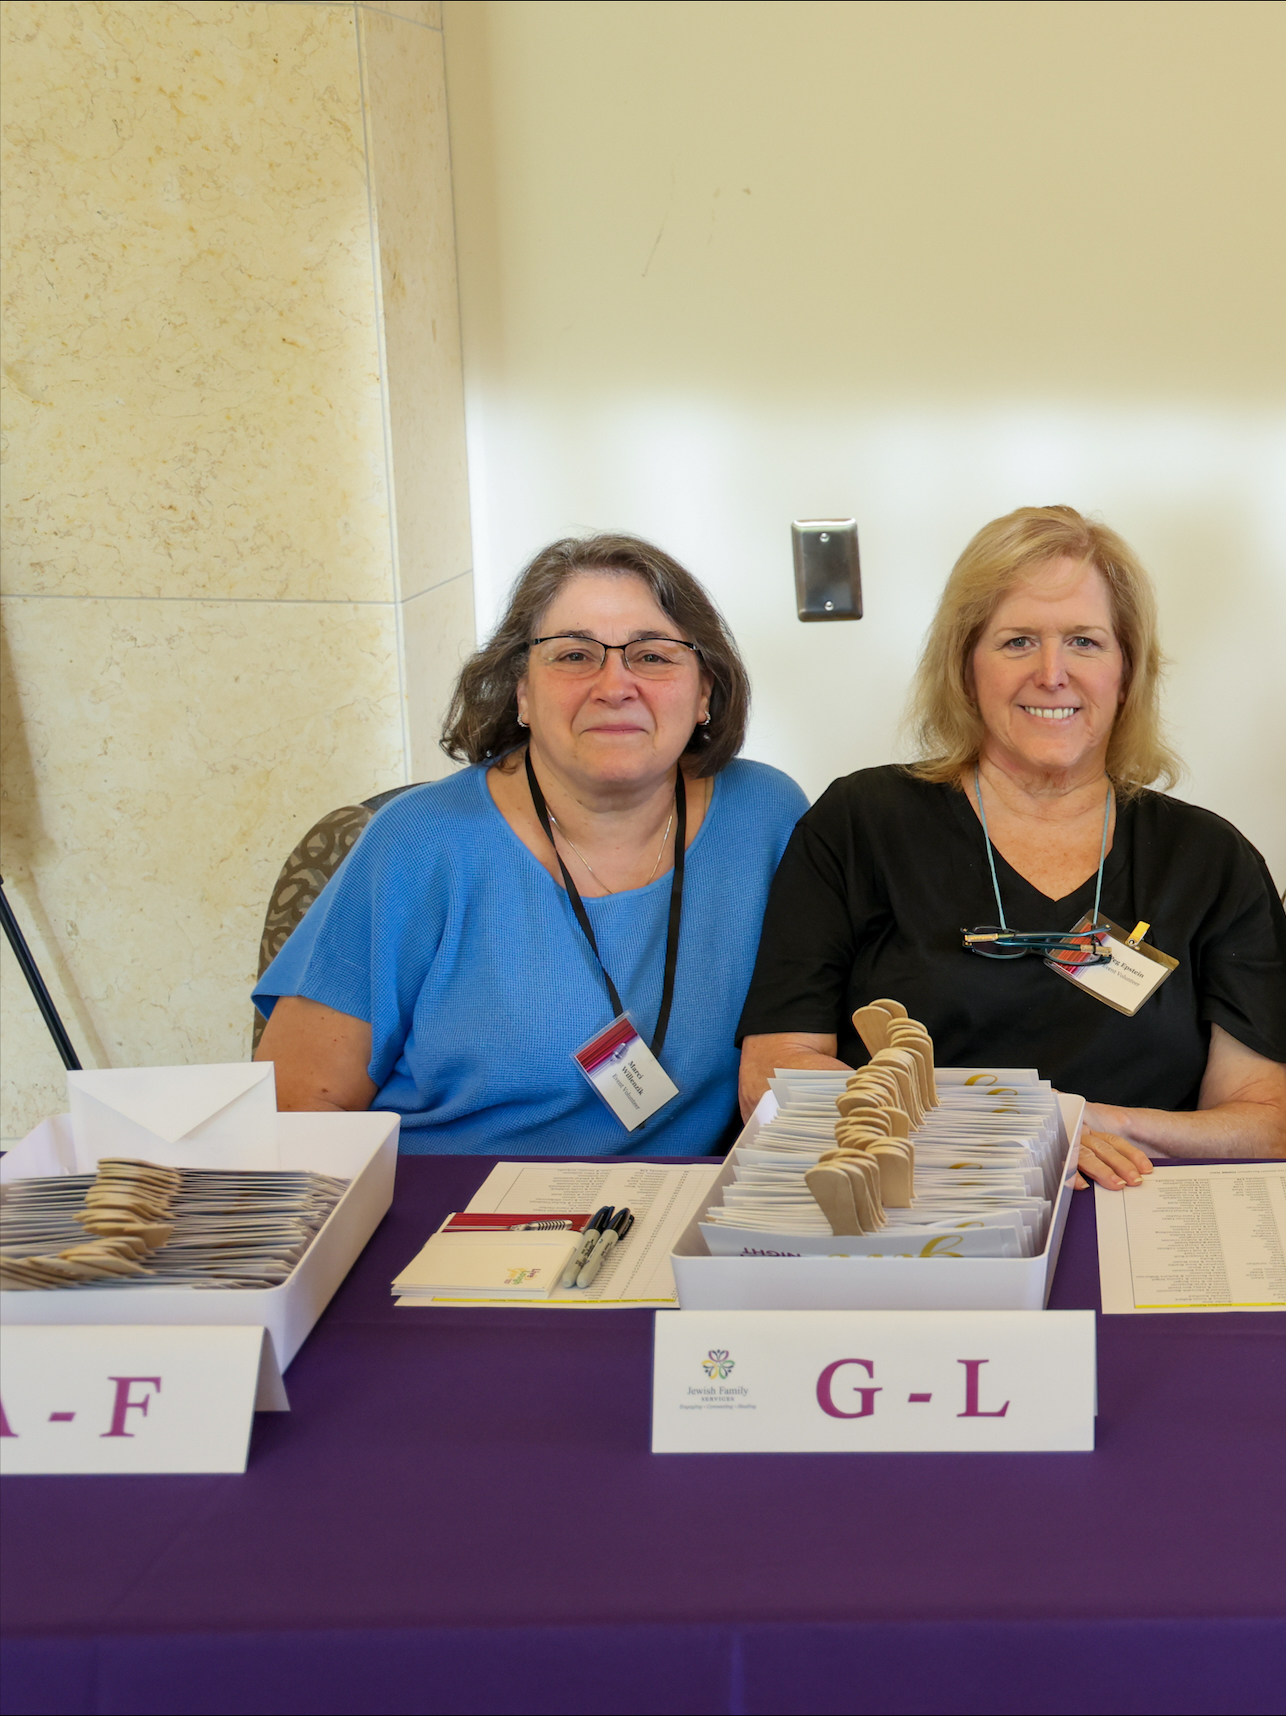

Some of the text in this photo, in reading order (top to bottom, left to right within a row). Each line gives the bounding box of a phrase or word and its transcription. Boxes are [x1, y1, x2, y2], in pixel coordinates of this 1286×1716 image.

[1117, 971, 1140, 987] Volunteer
[1121, 962, 1144, 978] Epstein
[621, 1066, 644, 1096] Willenzik
[627, 1060, 645, 1080] Marci
[612, 1073, 640, 1110] Event Volunteer
[686, 1386, 749, 1397] Jewish Family
[816, 1358, 1010, 1419] G - L
[100, 1376, 162, 1438] F
